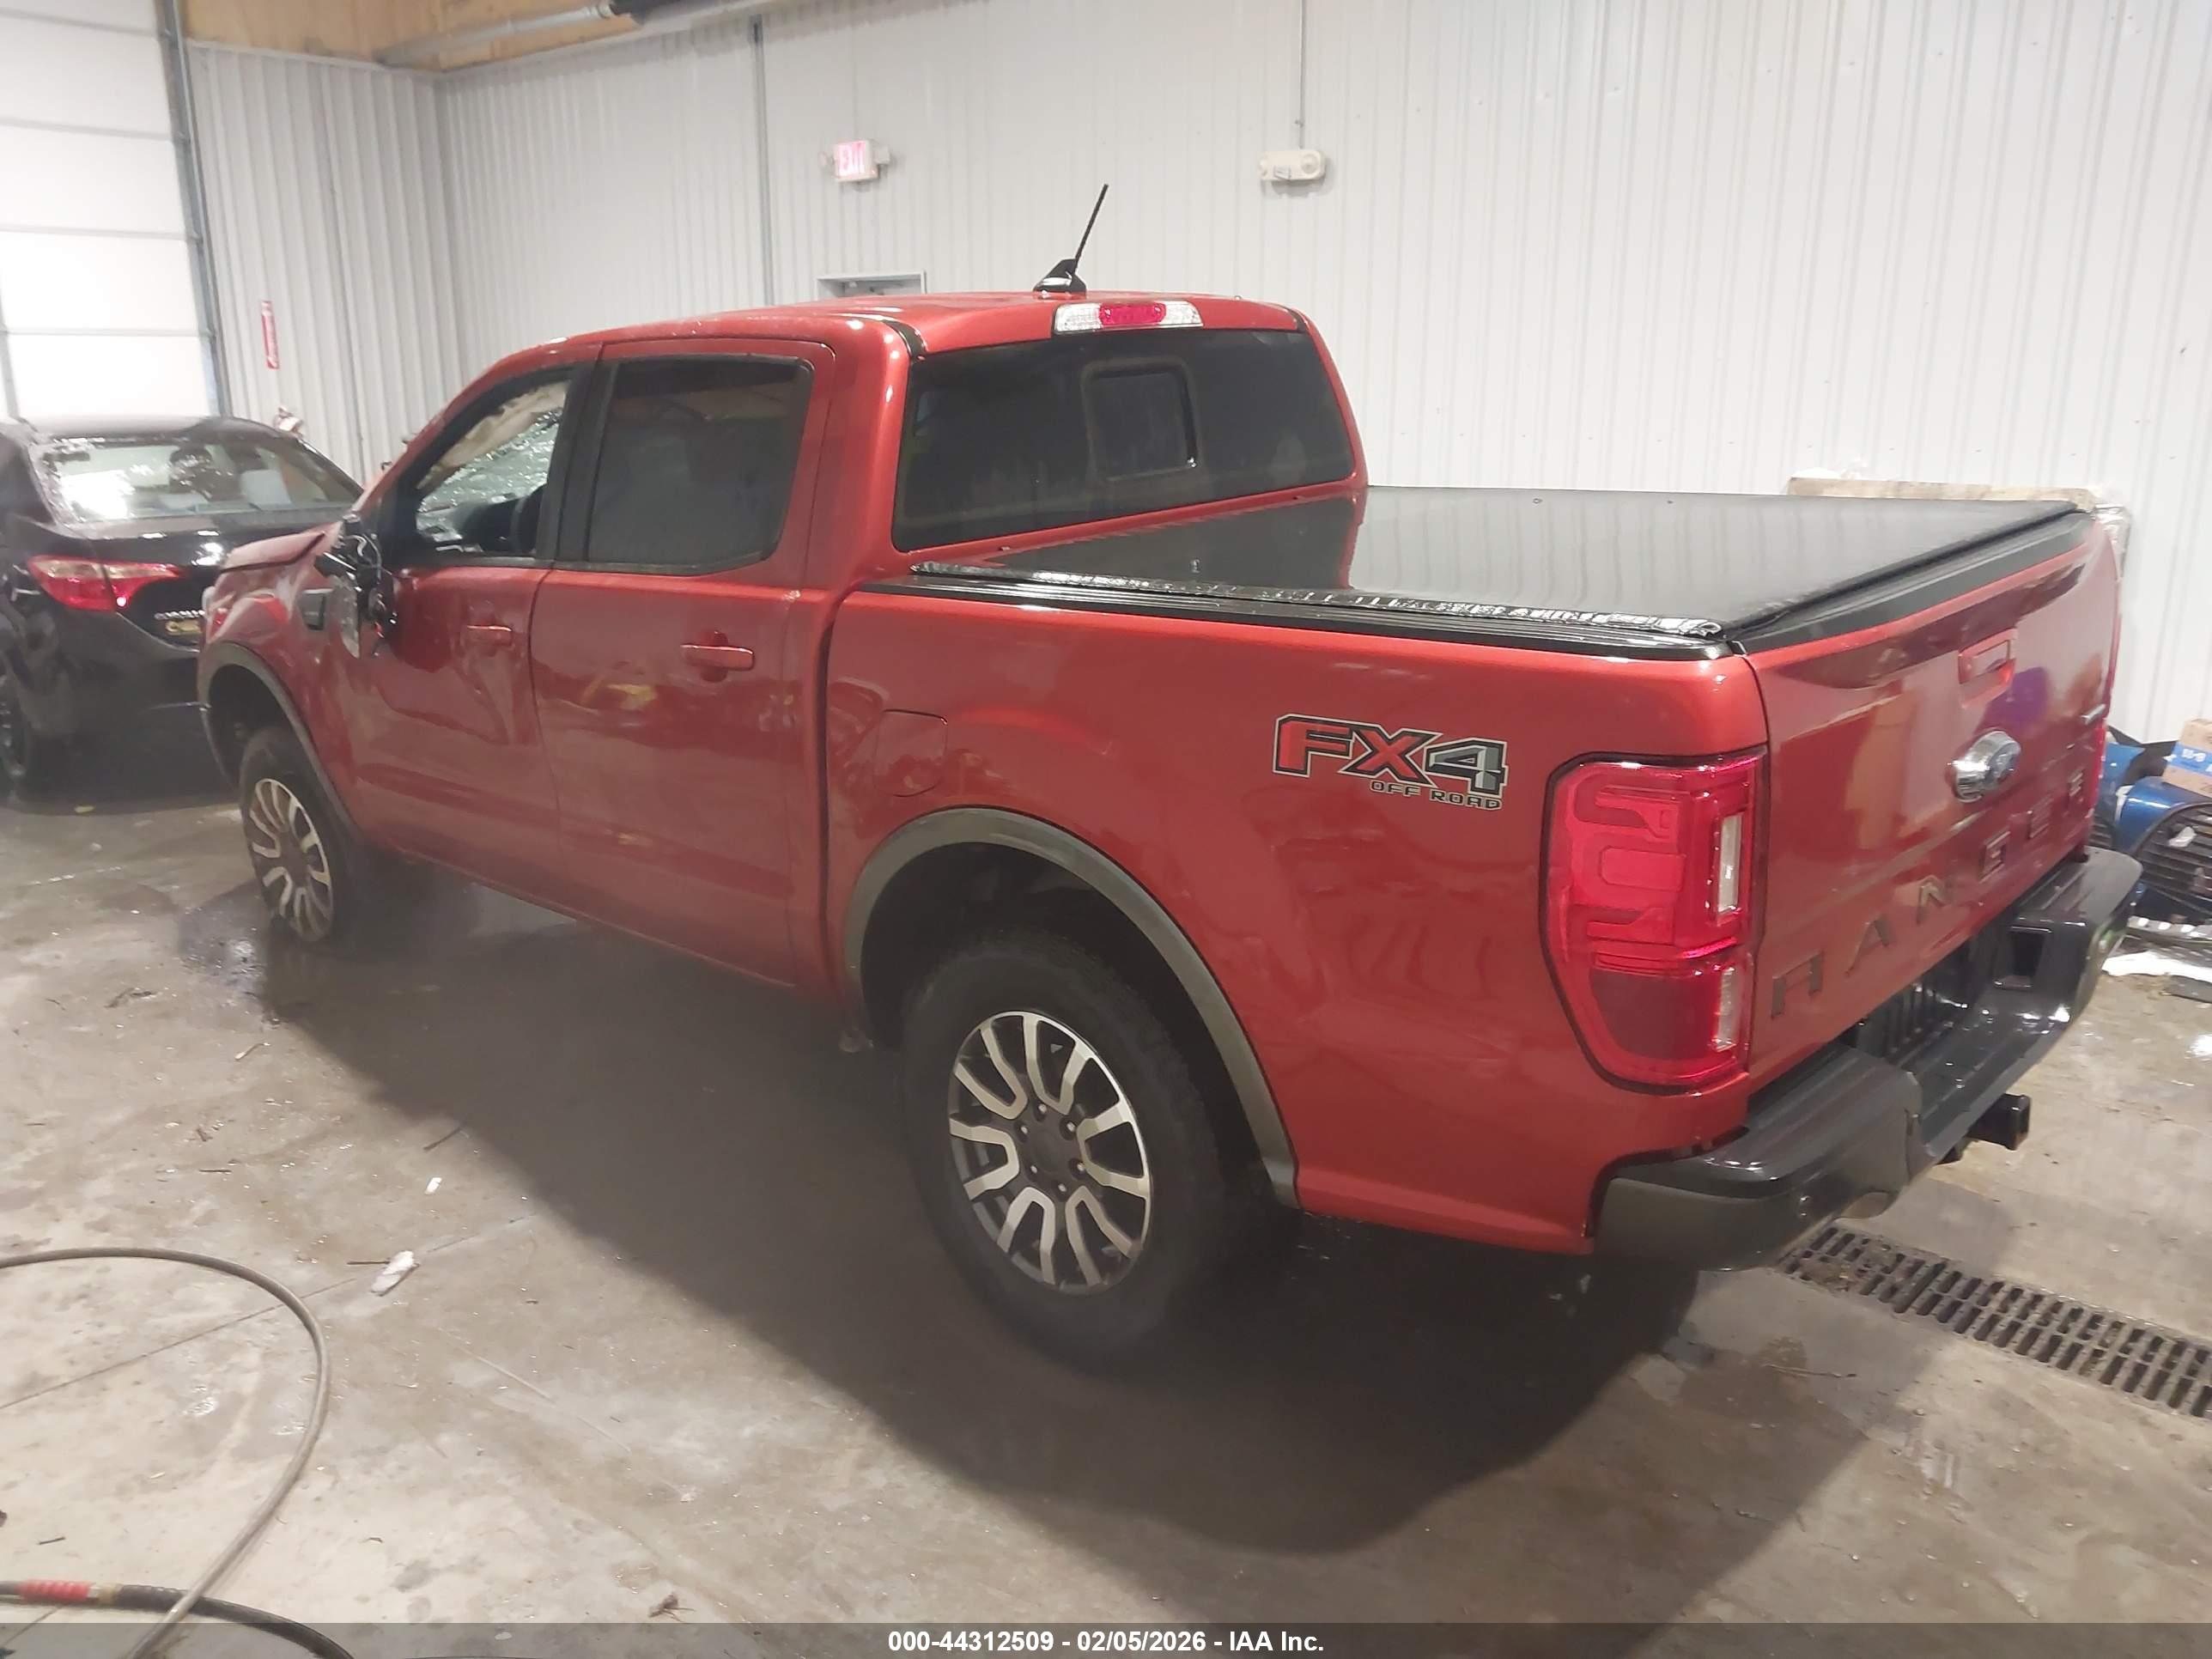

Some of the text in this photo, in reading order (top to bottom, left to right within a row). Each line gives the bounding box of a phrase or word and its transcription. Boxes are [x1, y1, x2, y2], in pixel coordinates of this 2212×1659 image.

[1273, 713, 1509, 797] FX4
[1370, 780, 1502, 810] OFF ROAD
